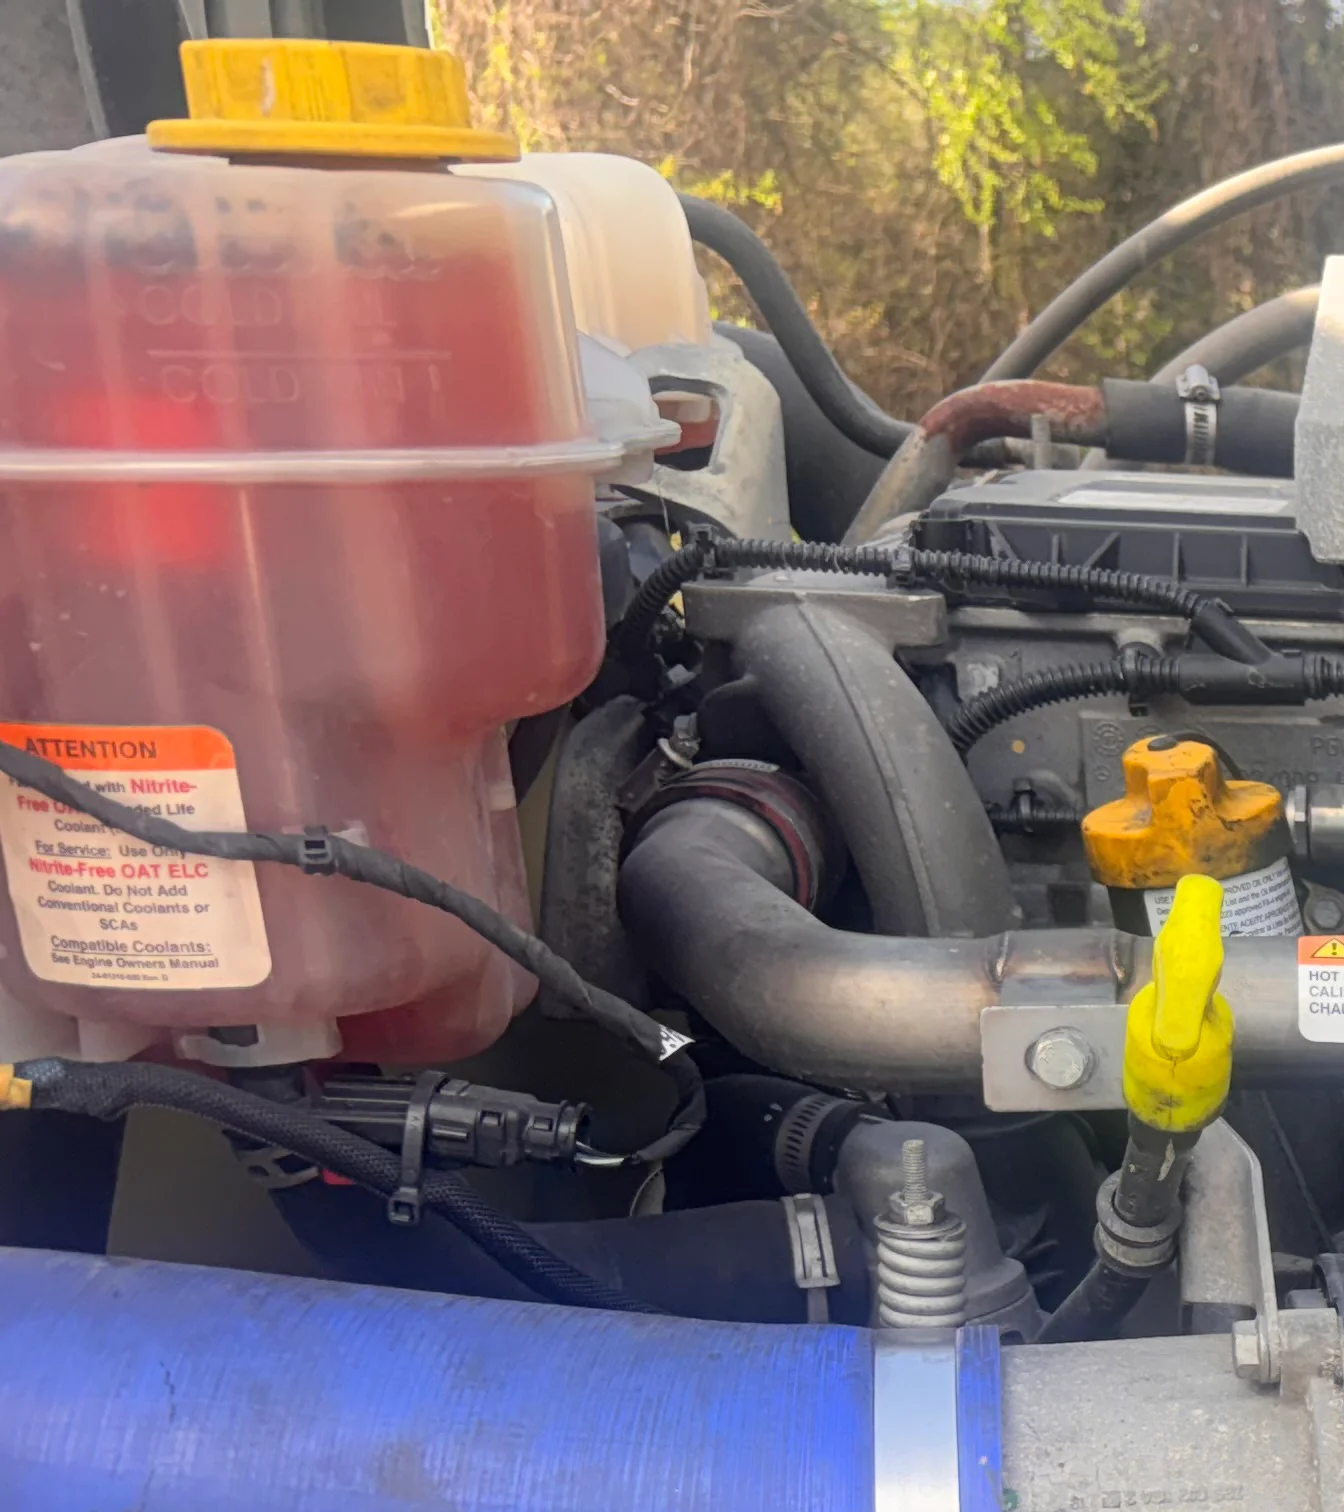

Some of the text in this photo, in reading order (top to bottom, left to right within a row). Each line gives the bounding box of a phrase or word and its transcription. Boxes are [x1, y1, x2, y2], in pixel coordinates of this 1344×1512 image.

[26, 738, 157, 759] ATTENTION
[130, 779, 197, 795] Nitrite-
[17, 795, 50, 813] Free
[167, 804, 195, 815] Life
[35, 839, 54, 855] For
[57, 841, 111, 857] Service:
[119, 845, 148, 857] Use
[28, 857, 209, 878] Nitrite-Free OAT ELC
[104, 884, 122, 897] Do
[127, 885, 151, 897] Not
[158, 885, 188, 897] Add
[38, 896, 210, 914] Conventional Coolants or
[1154, 895, 1170, 905] USE
[99, 918, 138, 931] SCAs
[51, 935, 212, 955] Compatible Coolants:
[170, 957, 219, 968] Manual
[1309, 971, 1340, 982] HOT
